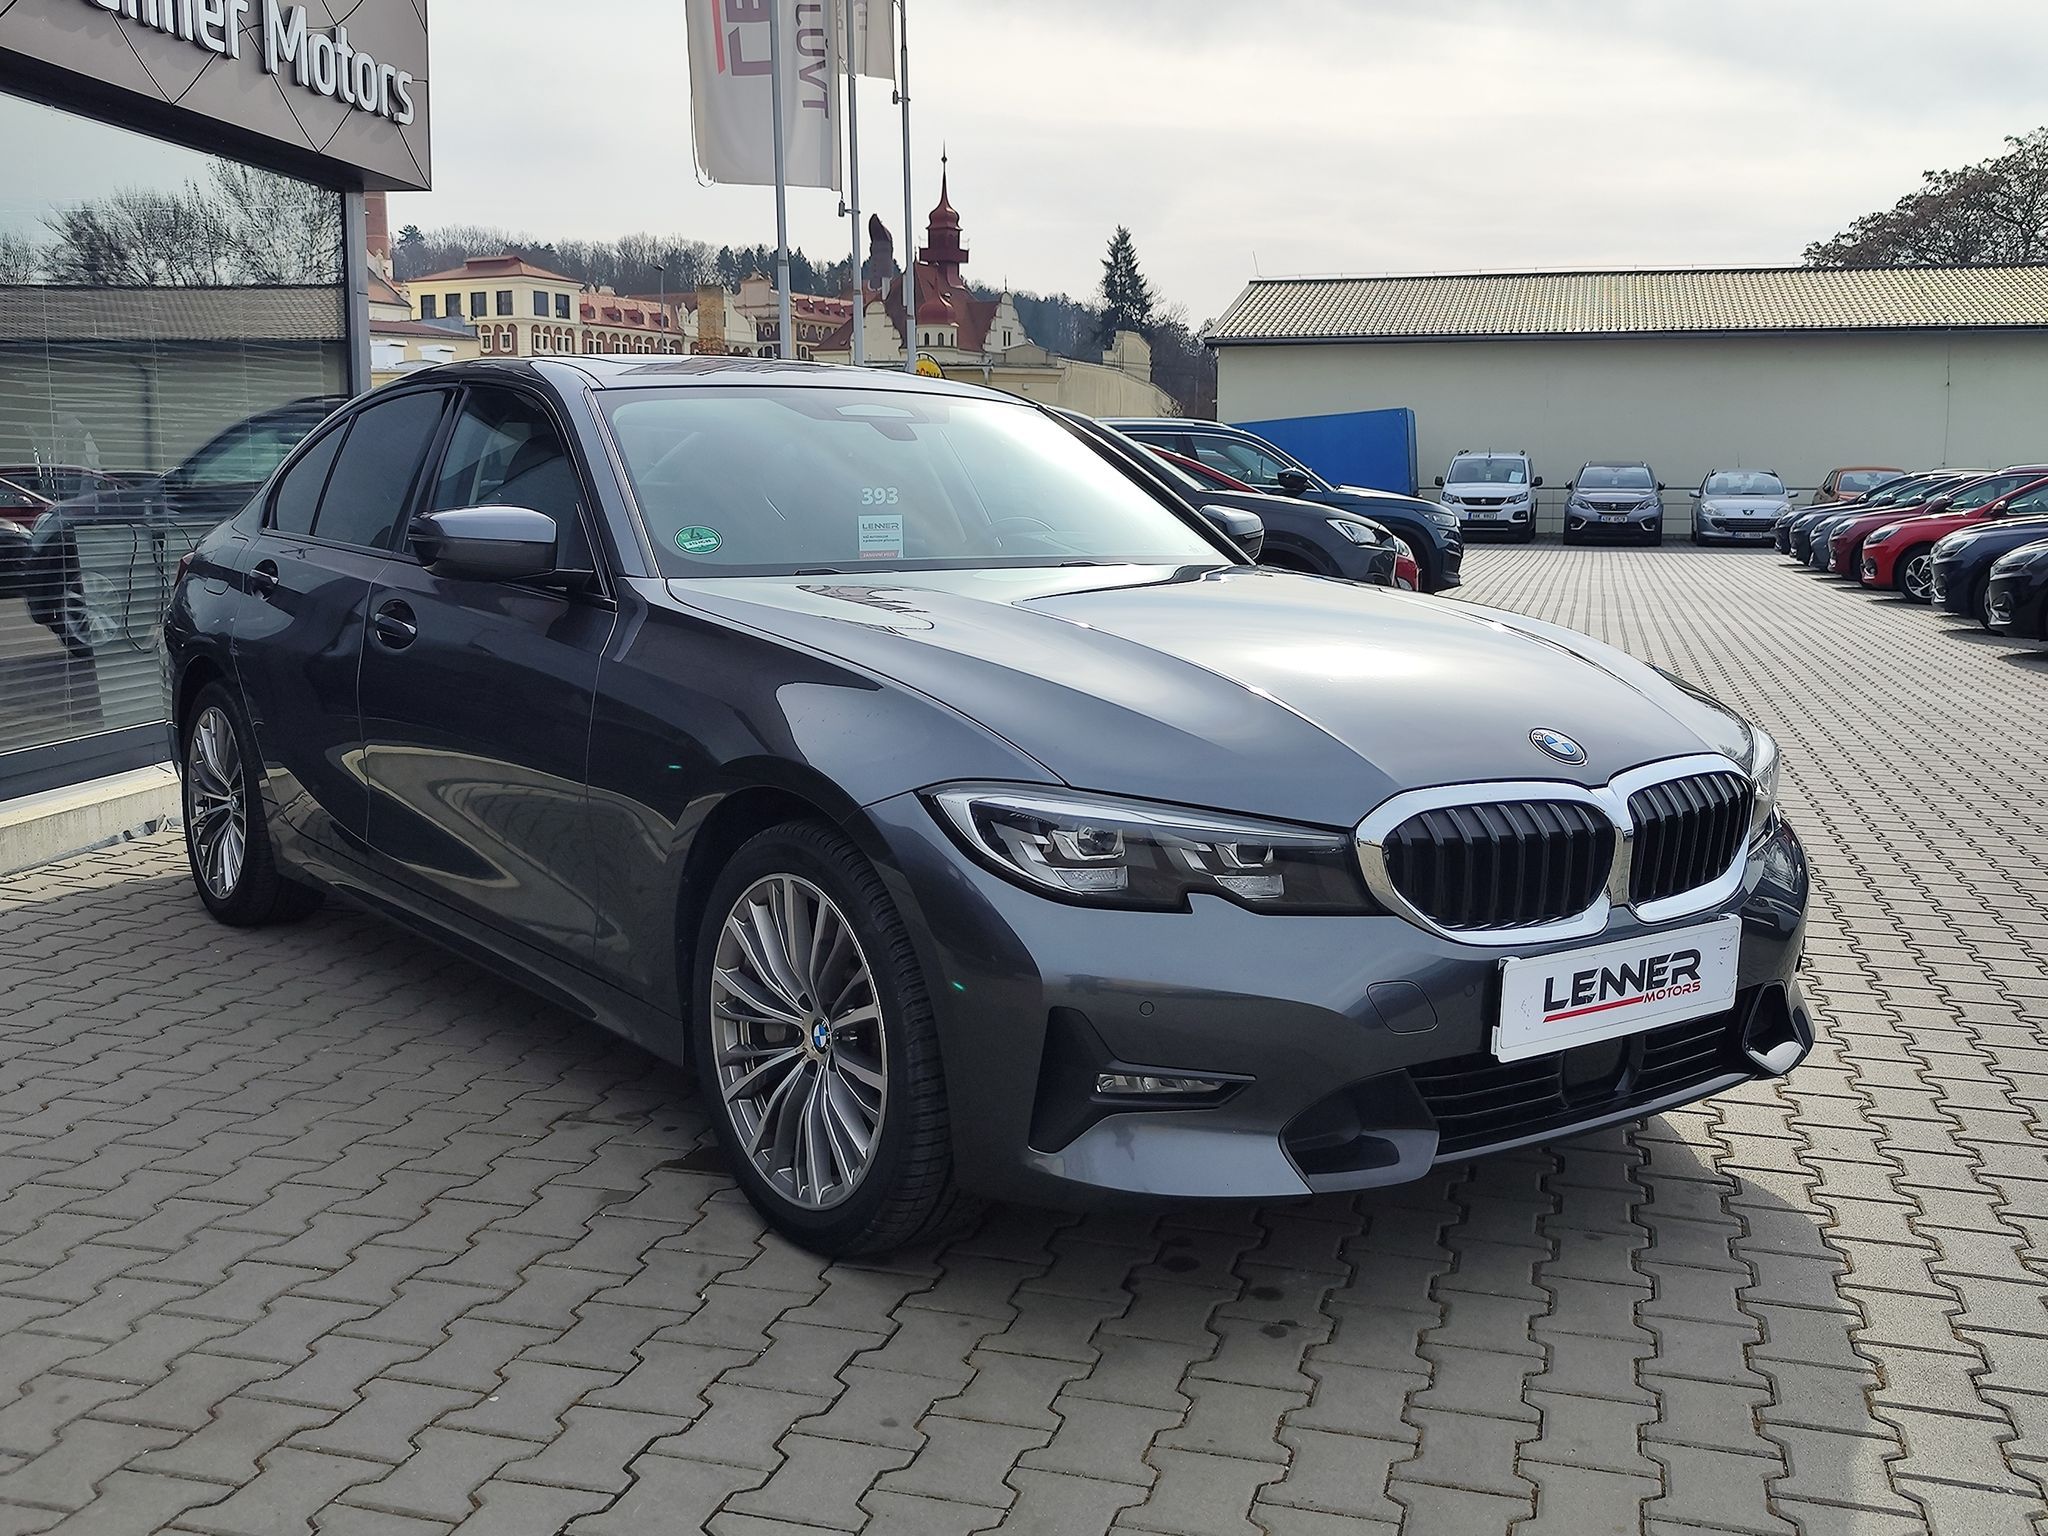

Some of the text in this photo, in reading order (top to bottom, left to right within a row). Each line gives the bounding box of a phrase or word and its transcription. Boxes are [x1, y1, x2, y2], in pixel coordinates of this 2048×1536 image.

[262, 0, 415, 126] Motors
[861, 487, 899, 505] 393
[1543, 948, 1702, 1013] LENNER
[1644, 981, 1701, 1003] MOTORS
